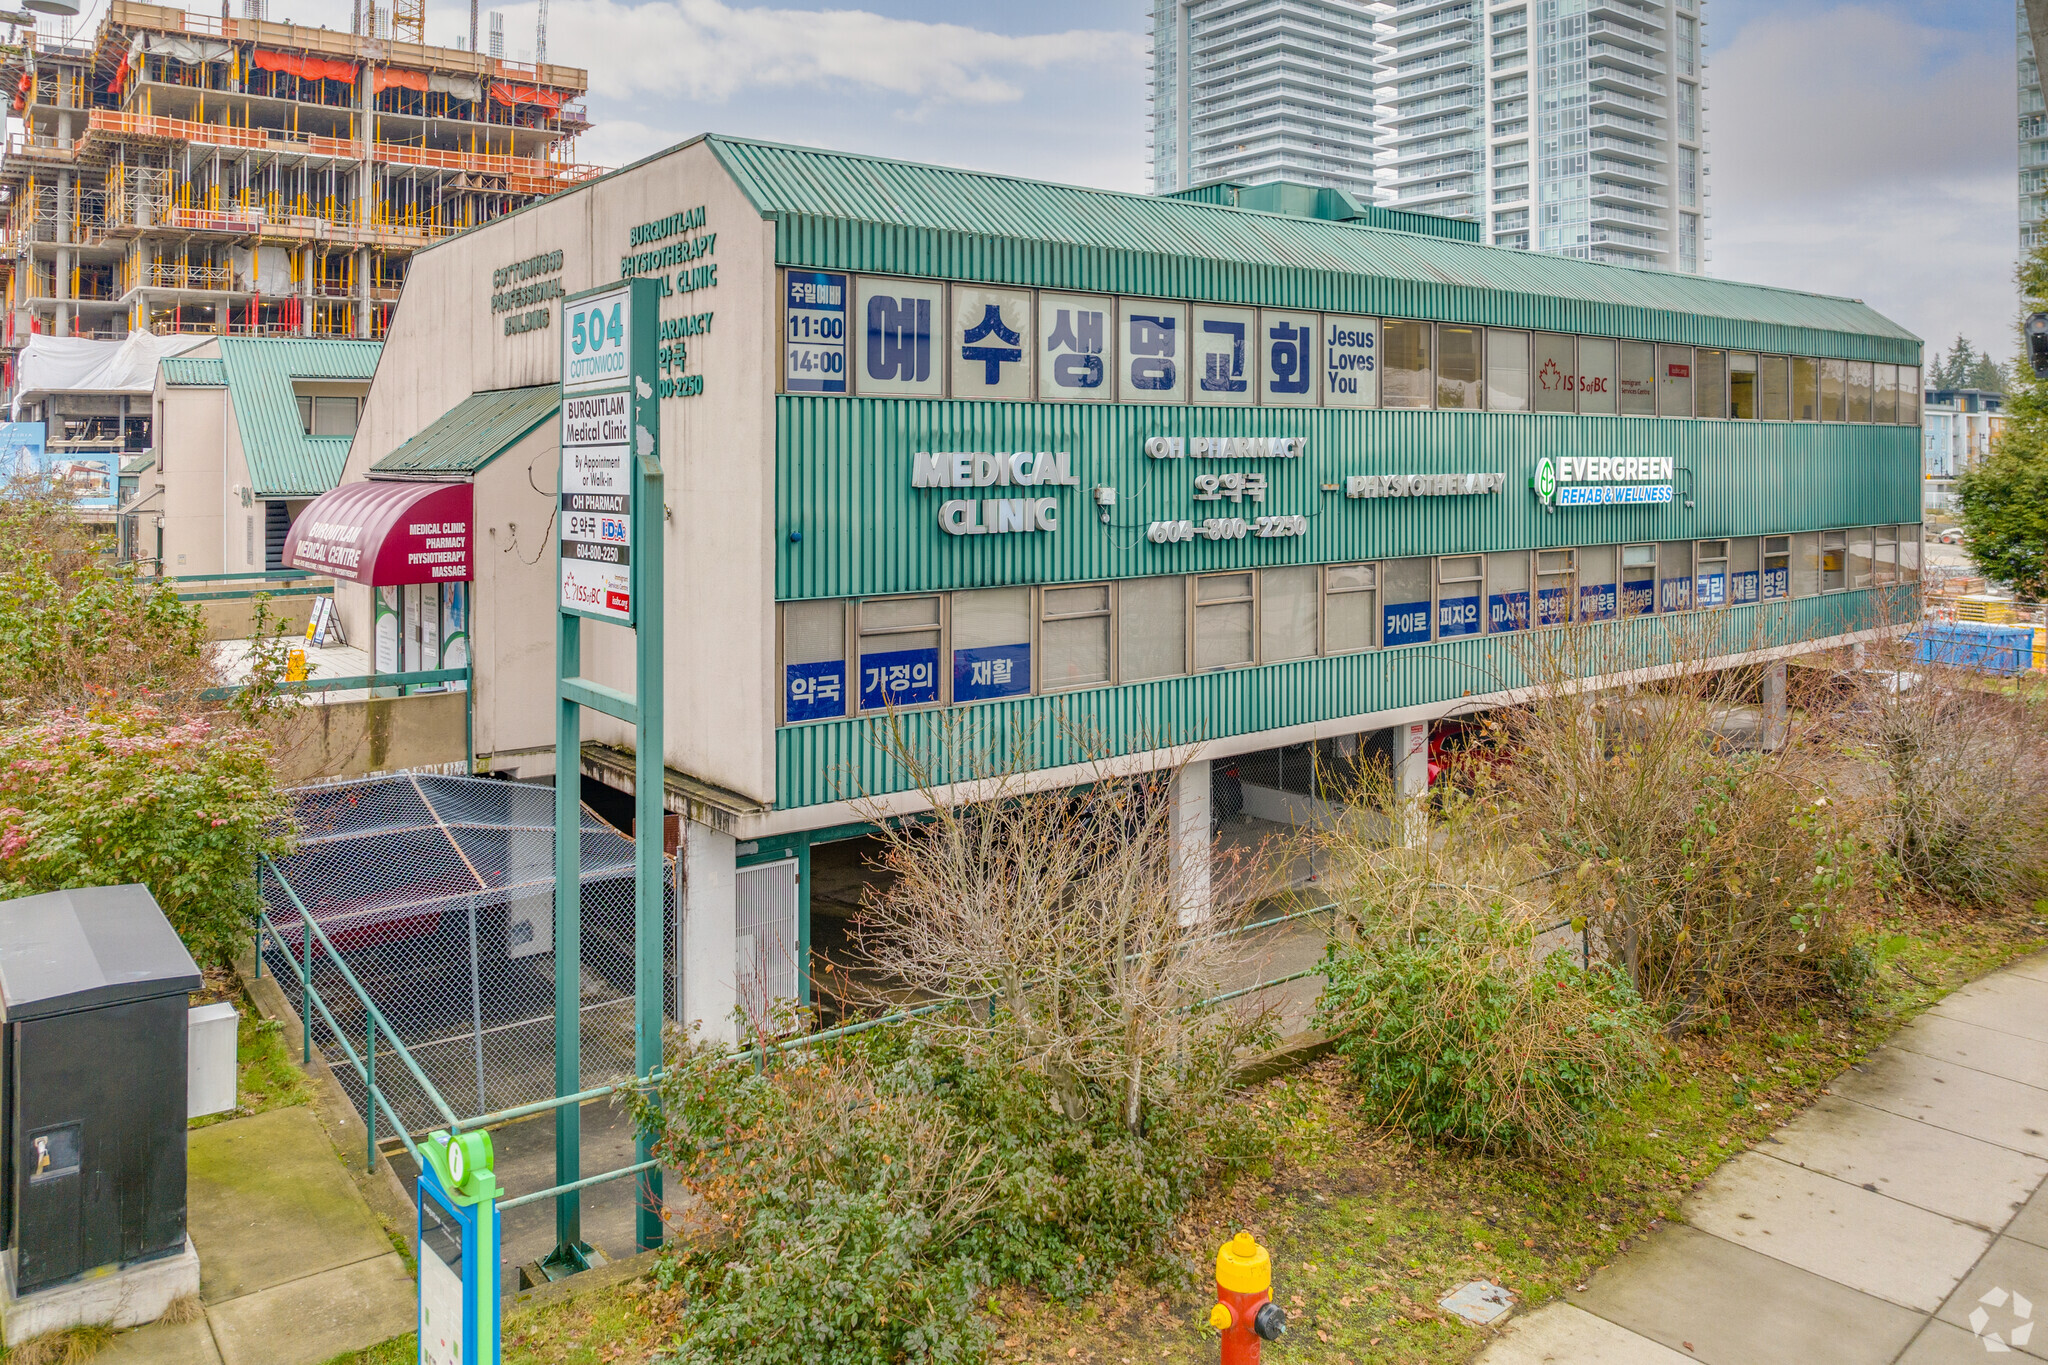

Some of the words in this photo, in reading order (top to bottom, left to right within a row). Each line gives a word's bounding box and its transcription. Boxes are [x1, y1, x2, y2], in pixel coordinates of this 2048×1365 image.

[630, 205, 706, 248] BURQUITLAM
[493, 249, 563, 288] COTTONWOOD
[620, 233, 717, 279] PHYSIOTHERAPY
[676, 264, 717, 294] CLINIC
[491, 276, 566, 315] PROFESSIONAL
[791, 282, 841, 306] 주일예배
[504, 307, 550, 337] BUILDING
[571, 303, 624, 355] 504
[659, 311, 714, 341] ARMACY
[790, 315, 843, 340] 11:00
[1328, 324, 1374, 349] Jesus
[570, 351, 625, 379] COTTONWOOD
[659, 343, 686, 375] 약국
[789, 350, 843, 374] 14:00
[1328, 348, 1375, 372] Loves
[659, 374, 704, 399] 00-2250
[1328, 371, 1358, 394] You
[568, 396, 625, 420] BURQUITLAM
[566, 421, 600, 442] Medical
[602, 420, 627, 440] Clinic
[1145, 437, 1184, 459] OH
[1190, 437, 1307, 459] PHARMACY
[575, 455, 582, 472] By
[583, 455, 620, 472] Appointment
[912, 452, 1080, 488] MEDICAL
[1556, 456, 1672, 481] EVERGREEN
[582, 476, 589, 486] or
[590, 472, 613, 486] Walk-in
[1193, 472, 1267, 503] 오약국
[1347, 472, 1506, 498] PHYSIOTHERAPY
[572, 495, 584, 509] OH
[585, 496, 623, 512] PHARMACY
[1561, 488, 1602, 504] REHAB
[1604, 488, 1612, 502] &
[1615, 487, 1672, 502] WELLNESS
[410, 523, 441, 535] MEDICAL
[442, 522, 466, 534] CLINIC
[570, 516, 596, 538] 오약국
[938, 497, 1057, 535] CLINIC
[309, 521, 363, 543] BURQUITLAM
[1147, 515, 1307, 544] 604-800-2250
[295, 540, 328, 562] MEDICAL
[328, 545, 361, 568] CENTRE
[426, 536, 466, 549] PHARMACY
[576, 543, 619, 562] 604-800-2250
[408, 551, 466, 565] PHYSIOTHERAPY
[432, 565, 467, 577] MASSAGE
[1662, 581, 1690, 608] 에버
[1697, 577, 1723, 602] 그린
[1732, 574, 1757, 600] 재활
[1763, 571, 1787, 597] 병원
[1387, 612, 1426, 635] 카이로
[1440, 604, 1477, 626] 피지오
[1492, 601, 1526, 623] 마사지
[866, 662, 933, 693] 가정의
[970, 658, 1013, 686] 재활
[791, 675, 840, 705] 약국
